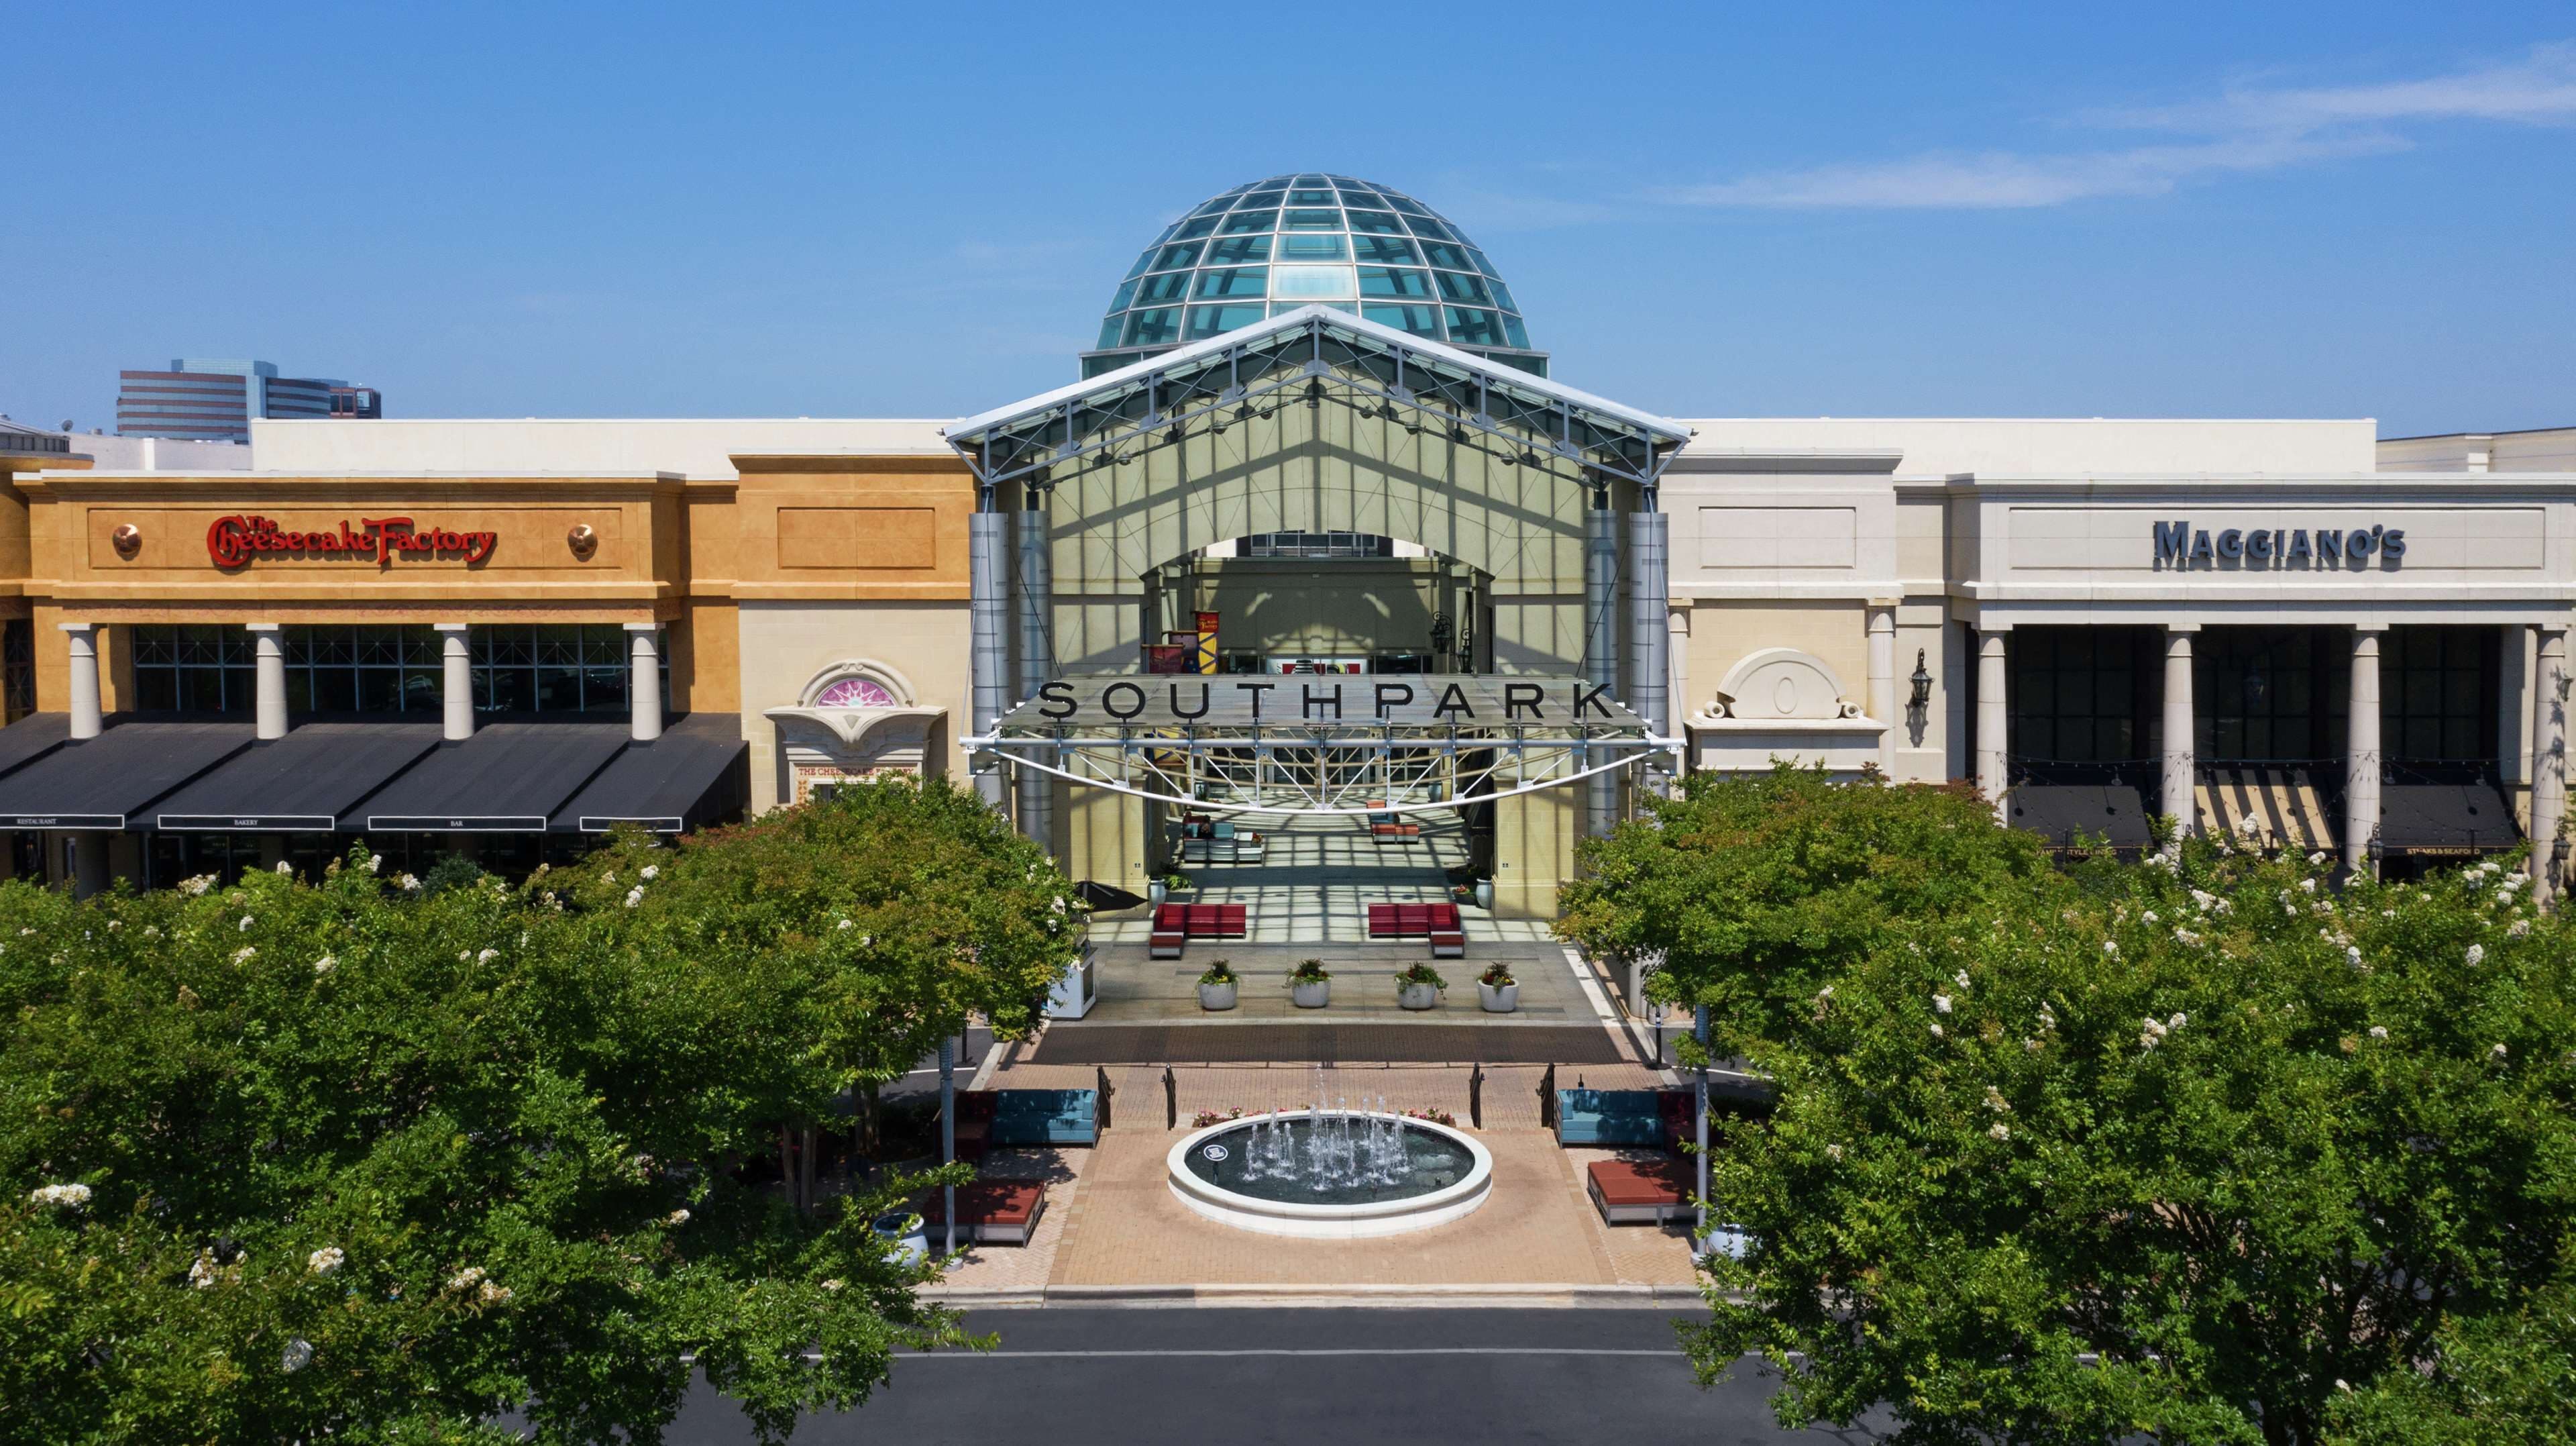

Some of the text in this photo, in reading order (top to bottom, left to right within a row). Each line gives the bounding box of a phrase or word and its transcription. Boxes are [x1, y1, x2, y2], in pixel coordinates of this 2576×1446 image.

[207, 514, 497, 567] Cheesecake Factory
[246, 515, 277, 531] The
[2154, 521, 2406, 559] MAGGIANO'S
[1038, 682, 1614, 720] SOUTHPARK
[798, 768, 816, 776] THE
